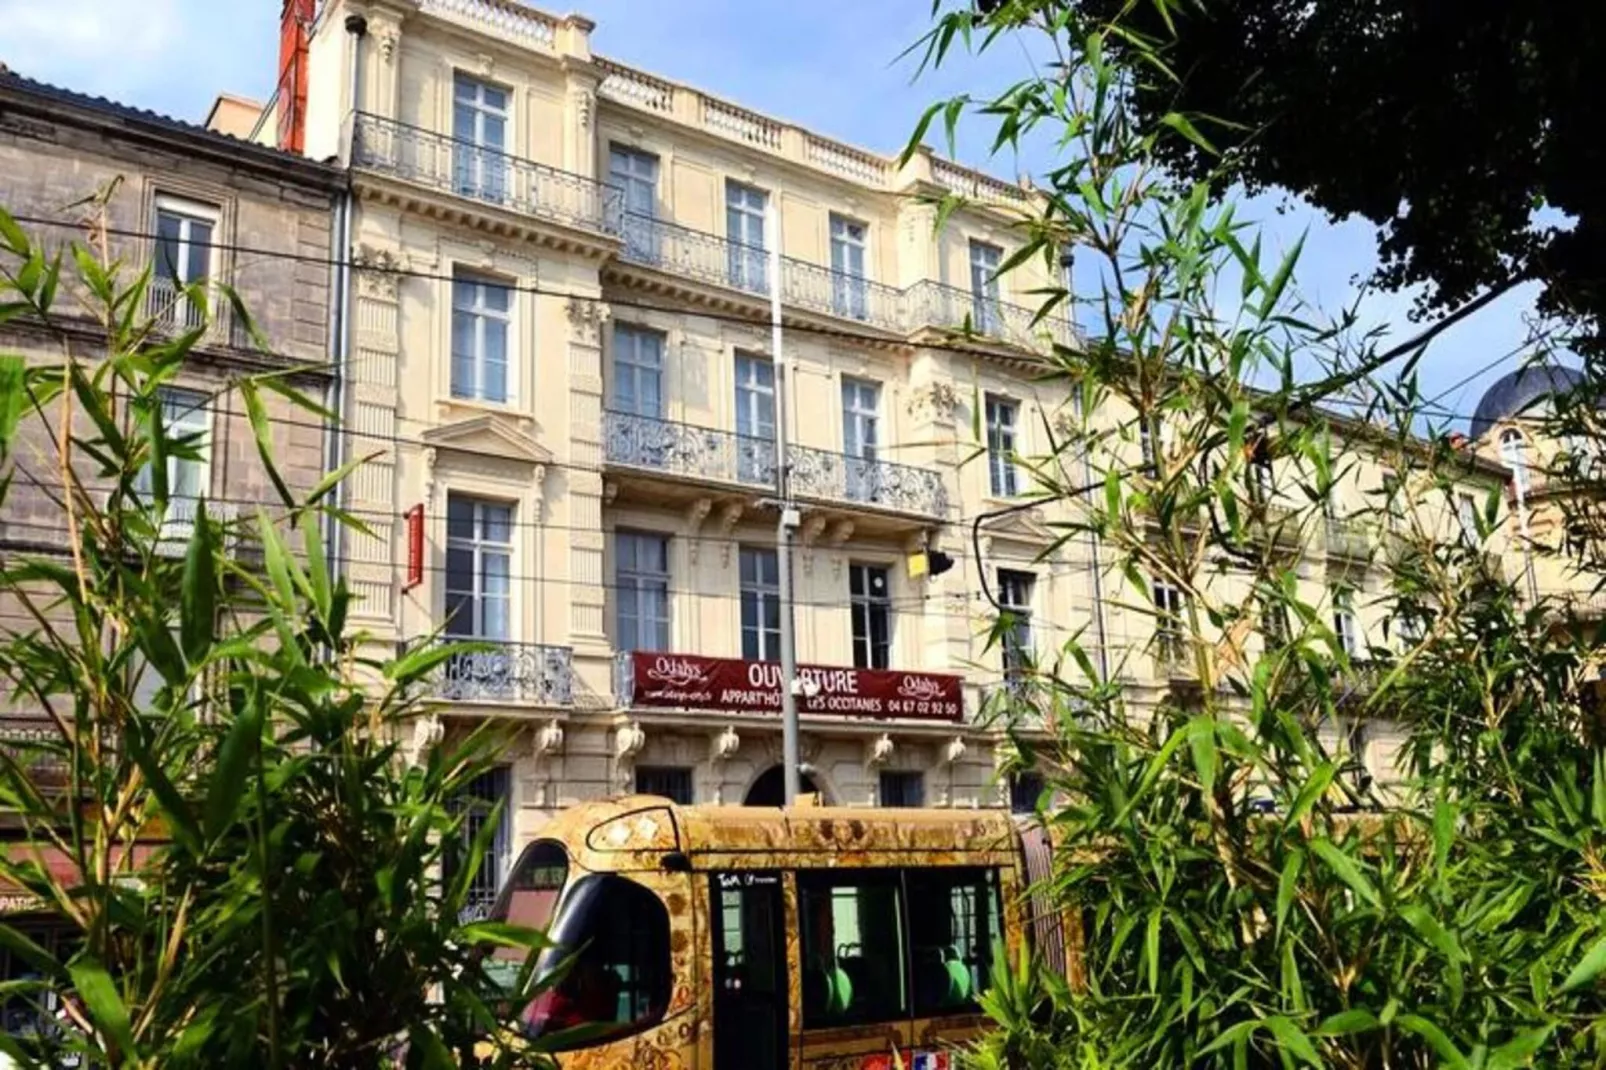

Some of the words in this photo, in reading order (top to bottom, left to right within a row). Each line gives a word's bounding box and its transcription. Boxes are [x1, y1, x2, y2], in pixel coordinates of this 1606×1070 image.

[748, 663, 859, 694] OURTURE
[827, 697, 882, 712] OCCITANES
[888, 699, 900, 712] 04
[917, 701, 929, 714] 02
